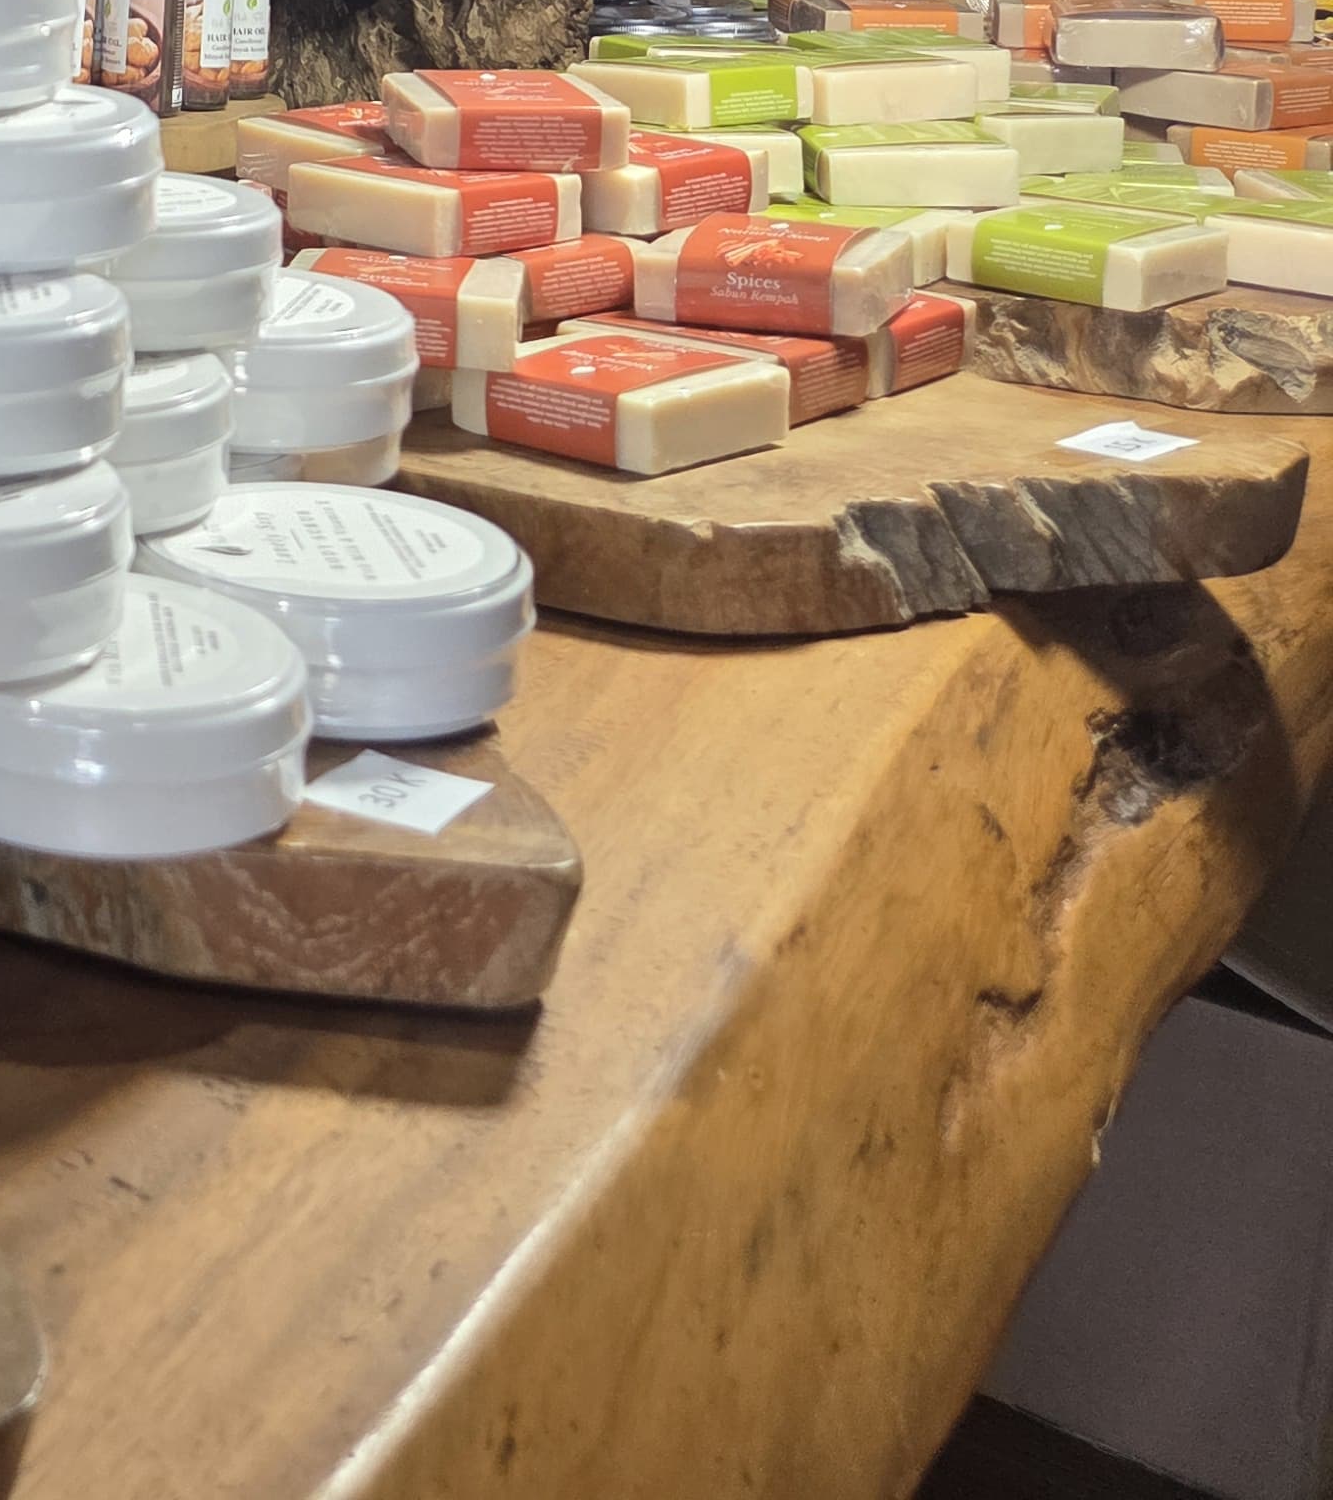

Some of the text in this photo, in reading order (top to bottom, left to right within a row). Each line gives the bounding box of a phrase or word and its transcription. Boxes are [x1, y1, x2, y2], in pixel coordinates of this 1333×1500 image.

[207, 33, 228, 43] HAIR
[717, 227, 831, 243] Natural Soap
[726, 271, 781, 290] Spices
[709, 285, 748, 299] Sabun
[261, 532, 298, 565] Lovely
[316, 543, 347, 570] BODY
